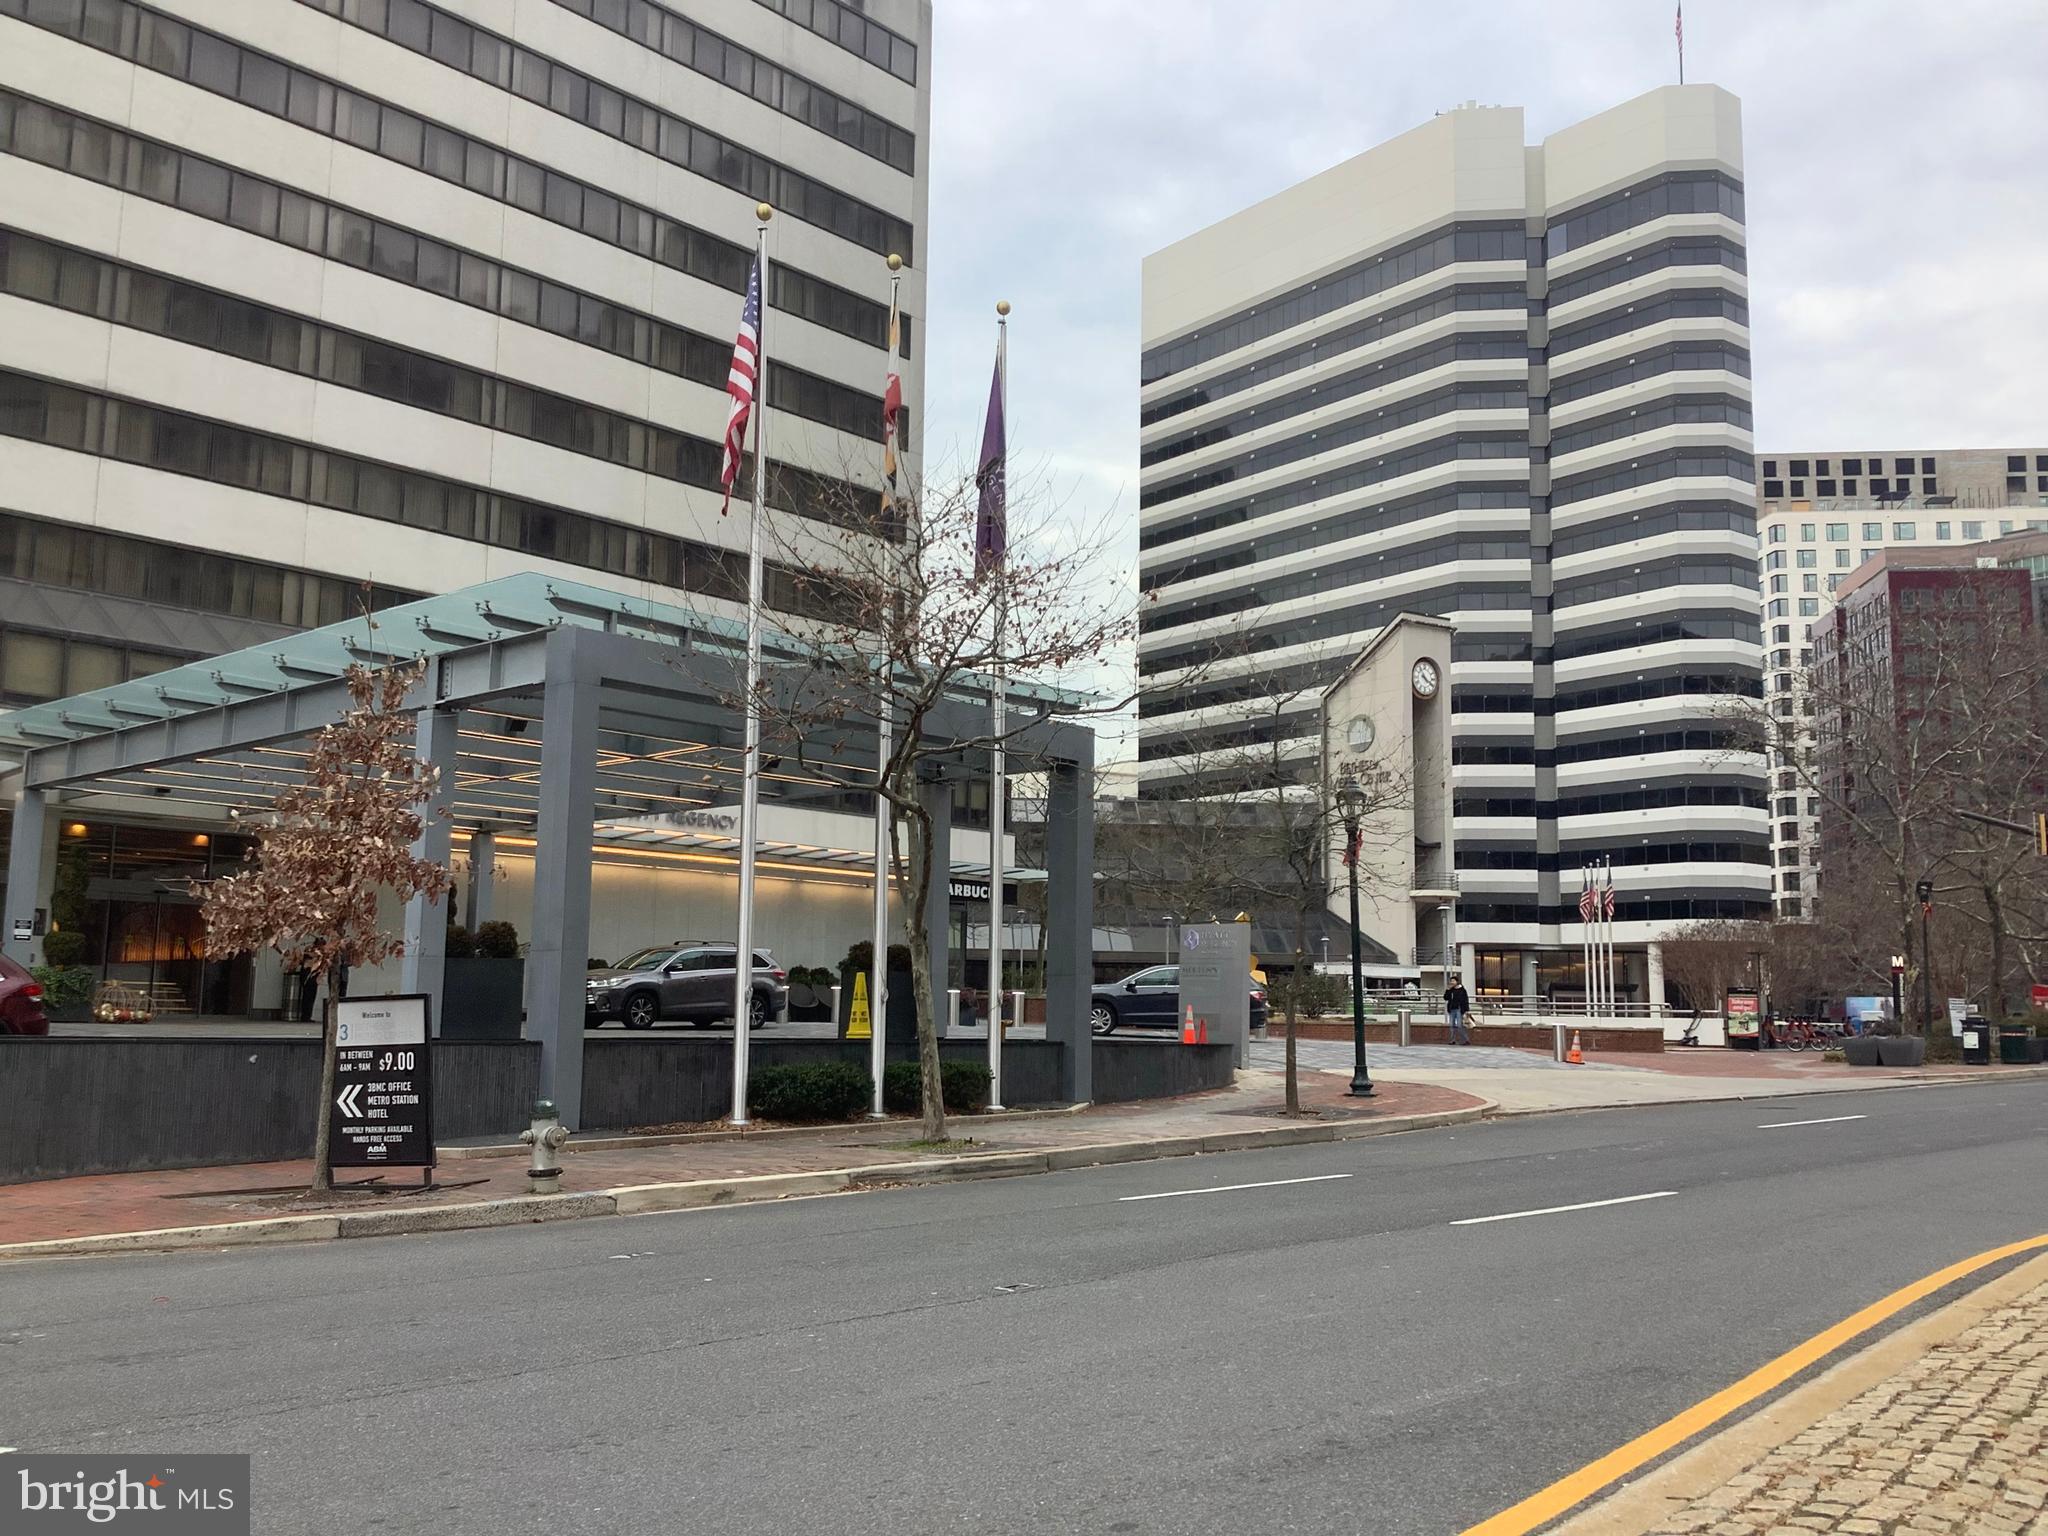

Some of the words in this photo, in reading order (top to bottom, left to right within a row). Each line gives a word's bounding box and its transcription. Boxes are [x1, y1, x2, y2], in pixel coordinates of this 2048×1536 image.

[949, 882, 990, 899] ARBUC
[1891, 956, 1904, 967] M
[340, 1024, 349, 1041] 3
[340, 1051, 347, 1060] IN
[347, 1050, 374, 1060] BETWEEN
[358, 1062, 371, 1071] 9AM
[379, 1051, 415, 1071] $9.00
[387, 1081, 412, 1092] OFFICE
[367, 1095, 390, 1106] METRO
[391, 1094, 419, 1105] STATION
[367, 1108, 389, 1119] HOTEL
[342, 1126, 364, 1134] MONTHLY
[387, 1125, 413, 1133] AVAILABLE
[383, 1134, 402, 1142] ACCESS
[367, 1145, 387, 1153] ABM
